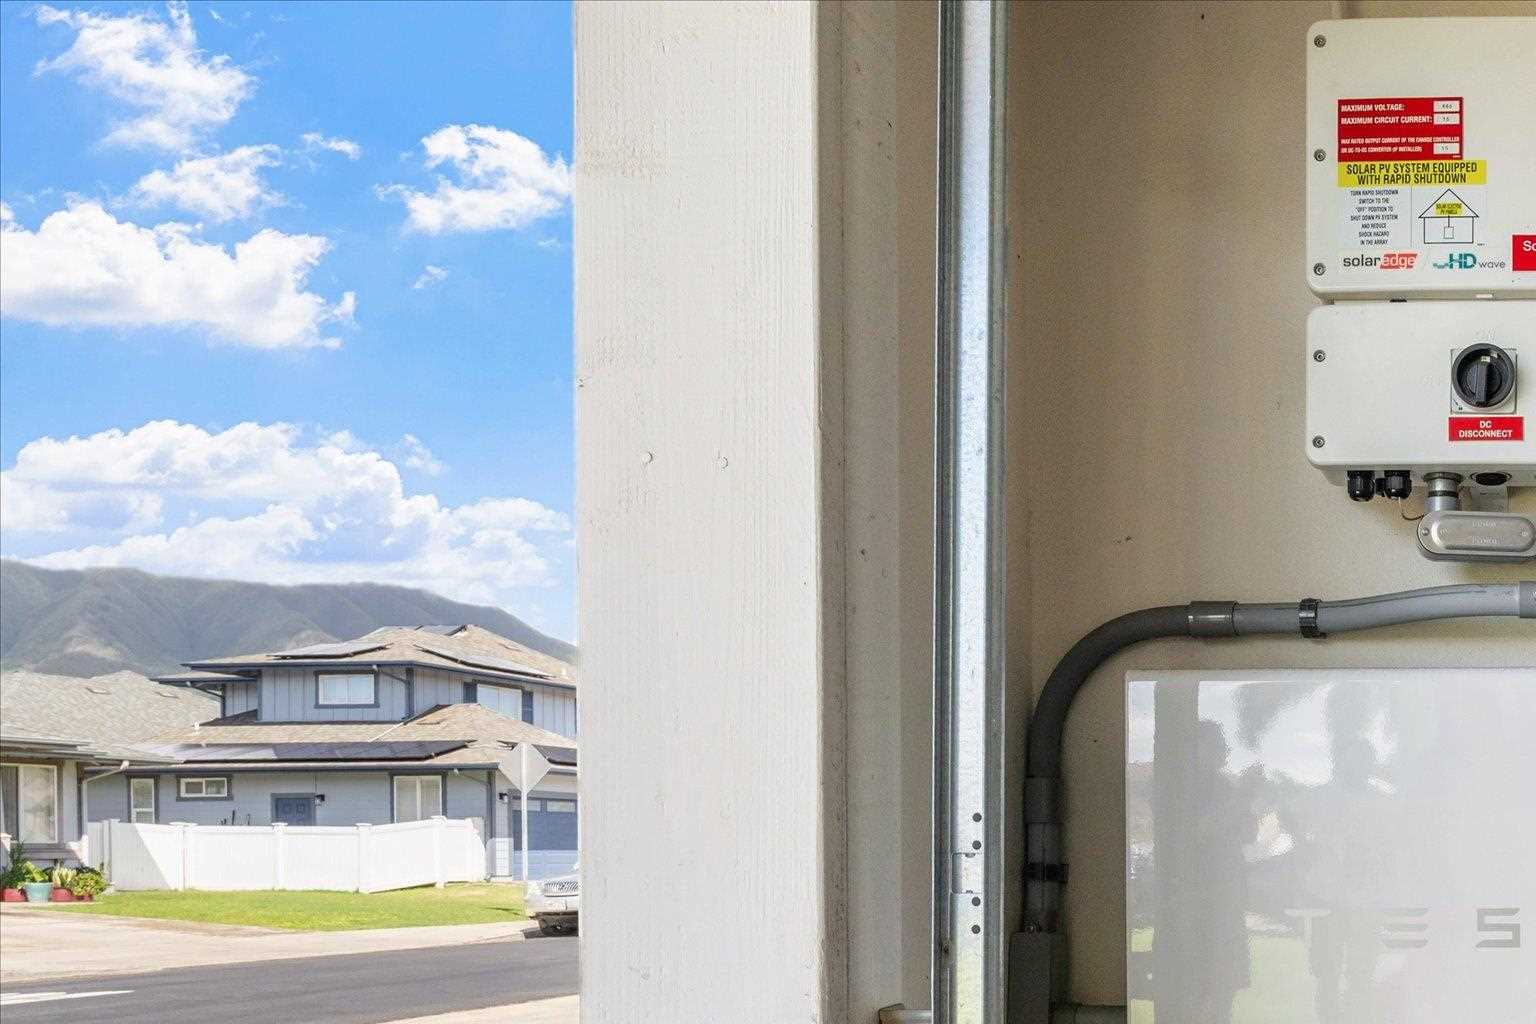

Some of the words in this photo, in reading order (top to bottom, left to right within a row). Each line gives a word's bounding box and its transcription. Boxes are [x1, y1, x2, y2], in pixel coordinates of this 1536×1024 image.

[1341, 104, 1373, 112] MAXIMUM
[1374, 103, 1405, 111] VOLTAGE:
[1341, 117, 1373, 125] MAXIMUM
[1374, 116, 1399, 124] CIRCUIT
[1400, 115, 1433, 124] CURRENT:
[1346, 164, 1376, 175] SOLAR
[1379, 163, 1391, 173] PV
[1393, 162, 1430, 173] SYSTEM
[1433, 162, 1477, 172] EQUIPPED
[1358, 174, 1380, 185] WITH
[1384, 174, 1411, 184] RAPID
[1414, 173, 1467, 183] SHUTDOWN
[1449, 253, 1477, 270] HD
[1478, 261, 1506, 269] wave
[1479, 420, 1493, 429] DC
[1458, 429, 1513, 438] DISCONNECT
